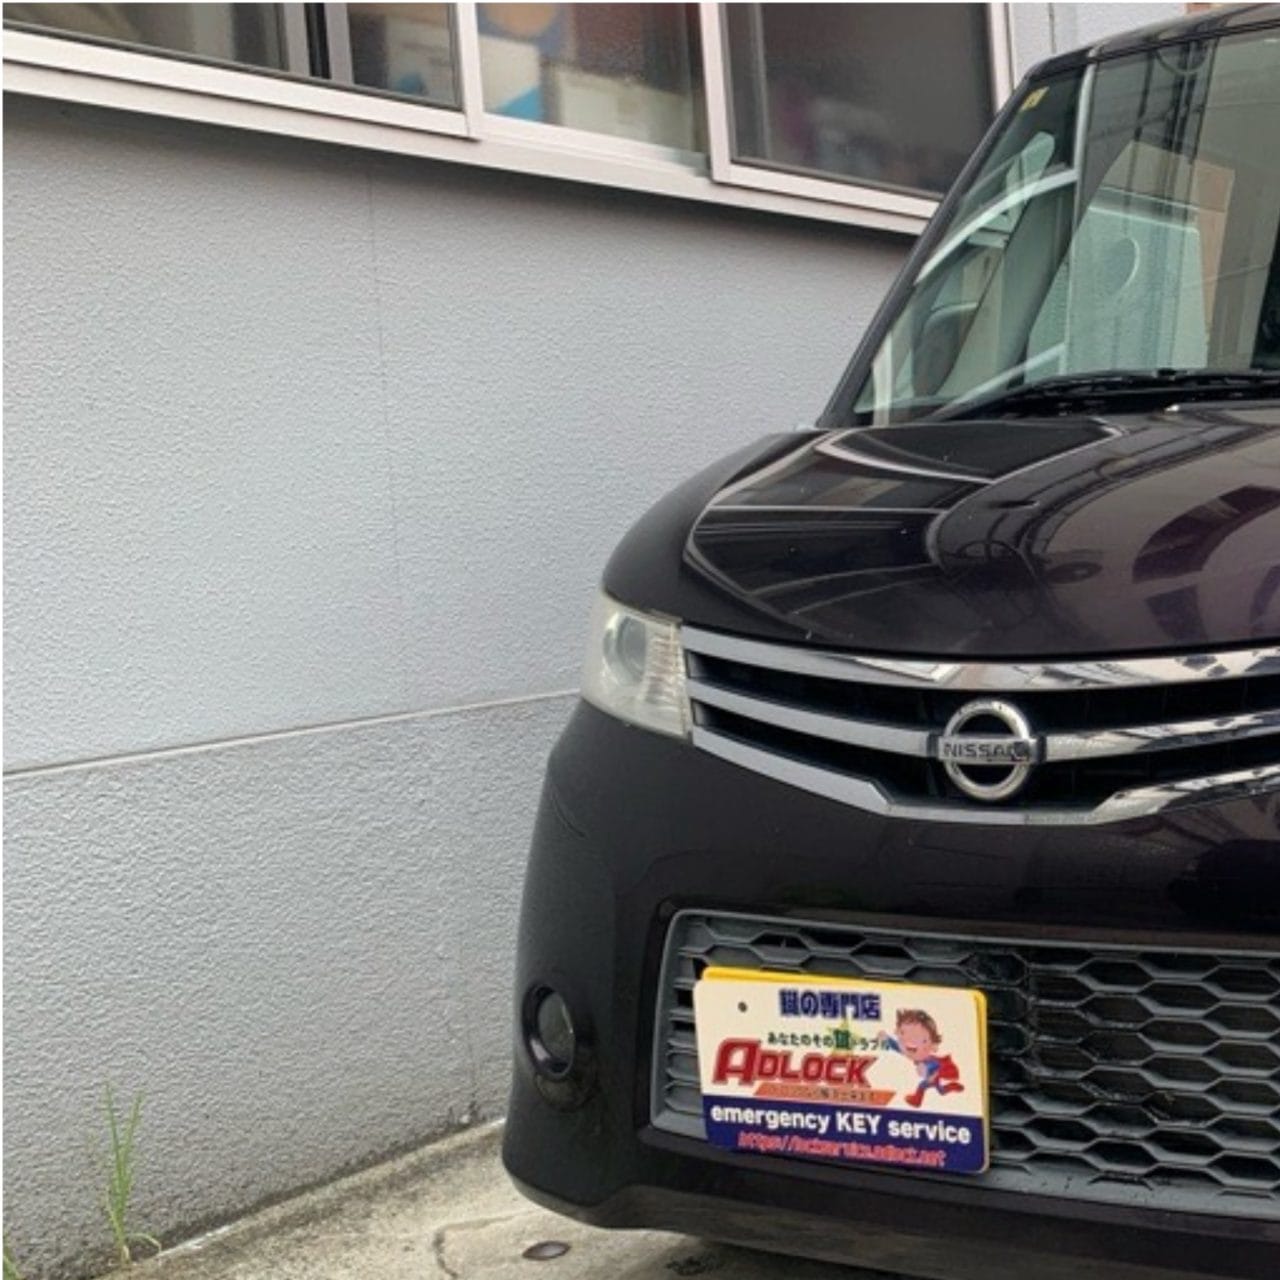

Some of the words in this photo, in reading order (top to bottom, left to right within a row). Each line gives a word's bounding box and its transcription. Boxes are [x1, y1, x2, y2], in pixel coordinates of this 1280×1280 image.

[712, 1037, 877, 1089] ADLOCK
[710, 1104, 831, 1134] emergency
[835, 1111, 881, 1135] KEY
[887, 1119, 972, 1145] service
